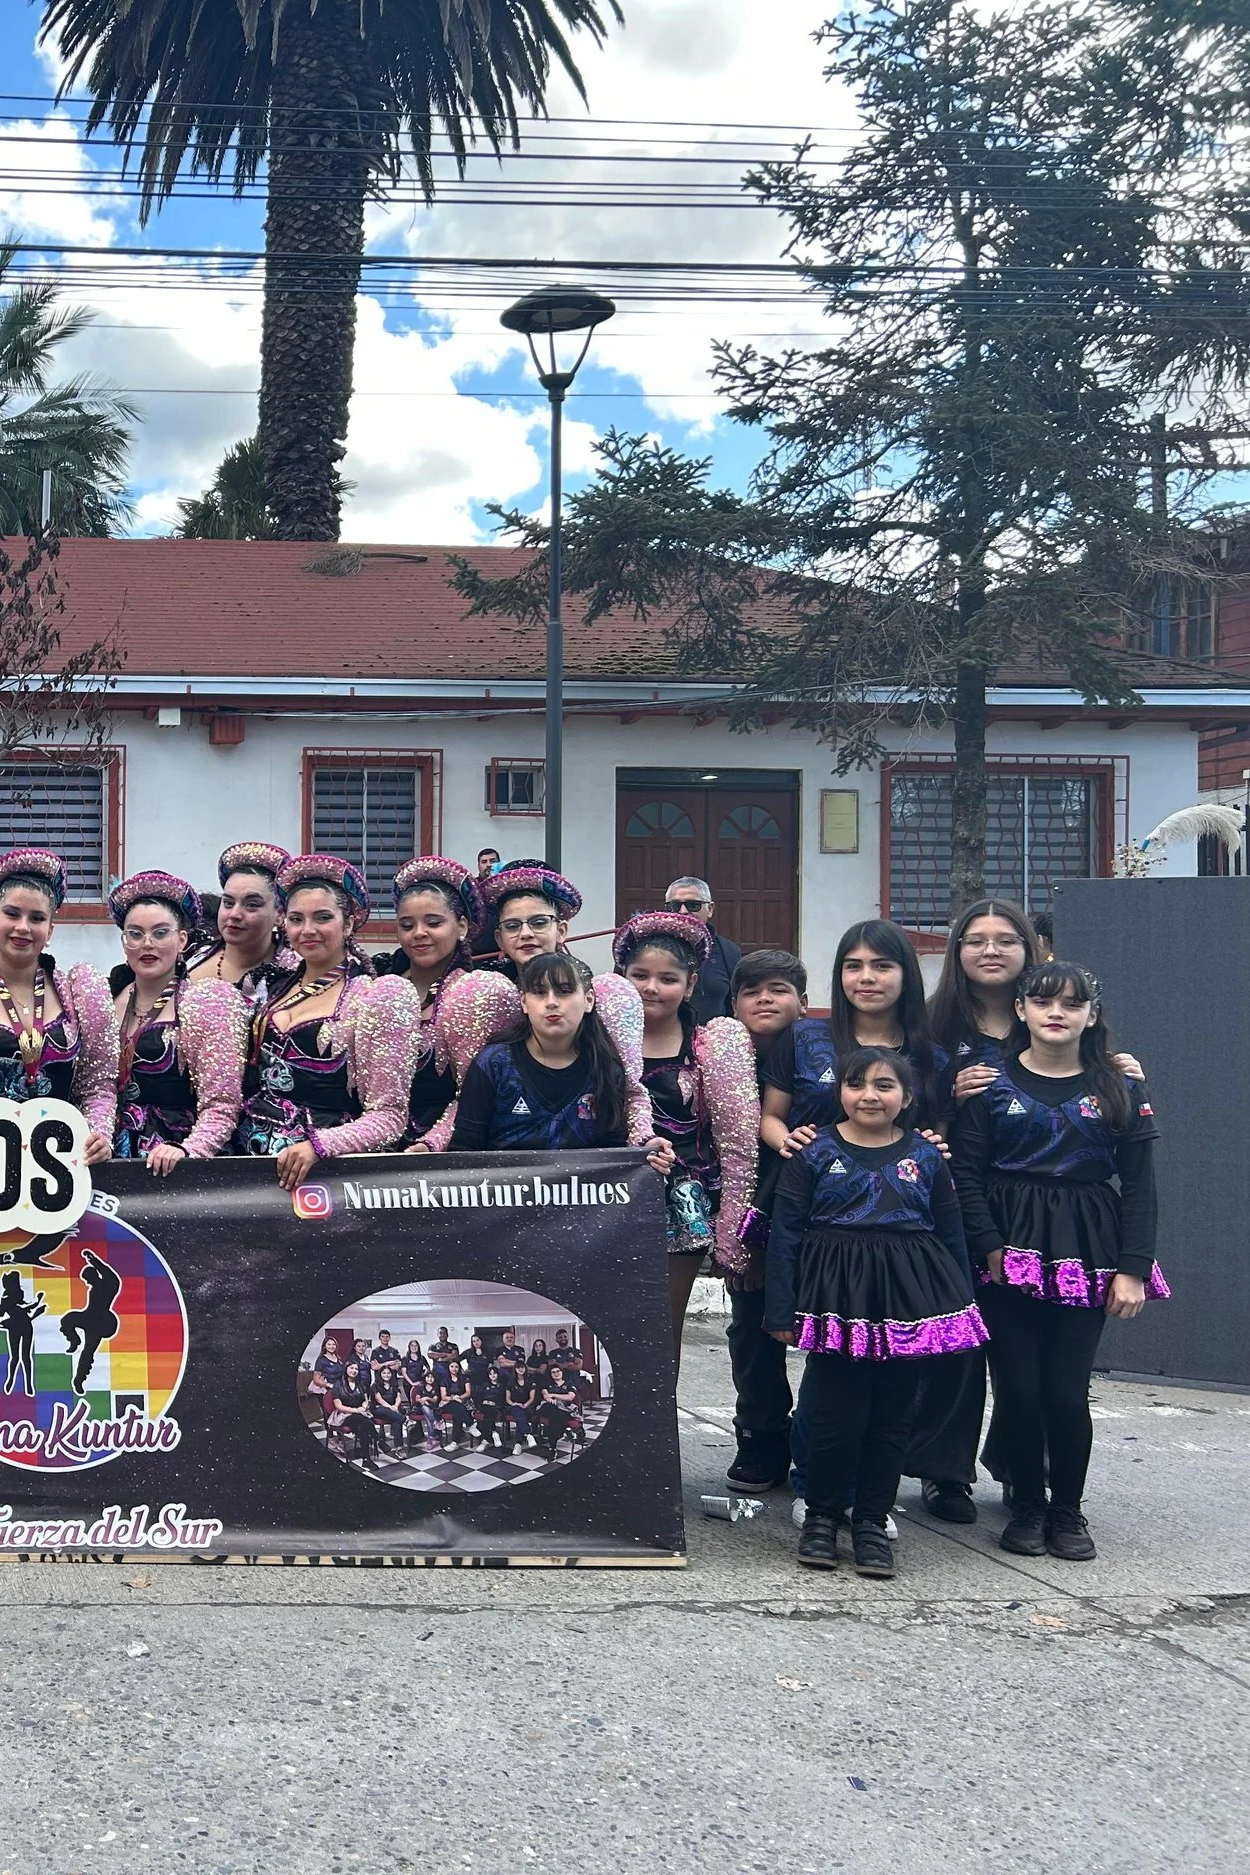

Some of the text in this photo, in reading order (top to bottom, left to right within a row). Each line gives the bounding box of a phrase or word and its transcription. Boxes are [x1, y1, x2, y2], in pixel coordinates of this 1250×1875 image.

[342, 1175, 632, 1210] Nunakuntur.bulnes
[46, 1401, 180, 1458] Kuntur
[88, 1506, 146, 1548] del
[152, 1503, 221, 1548] Sur
